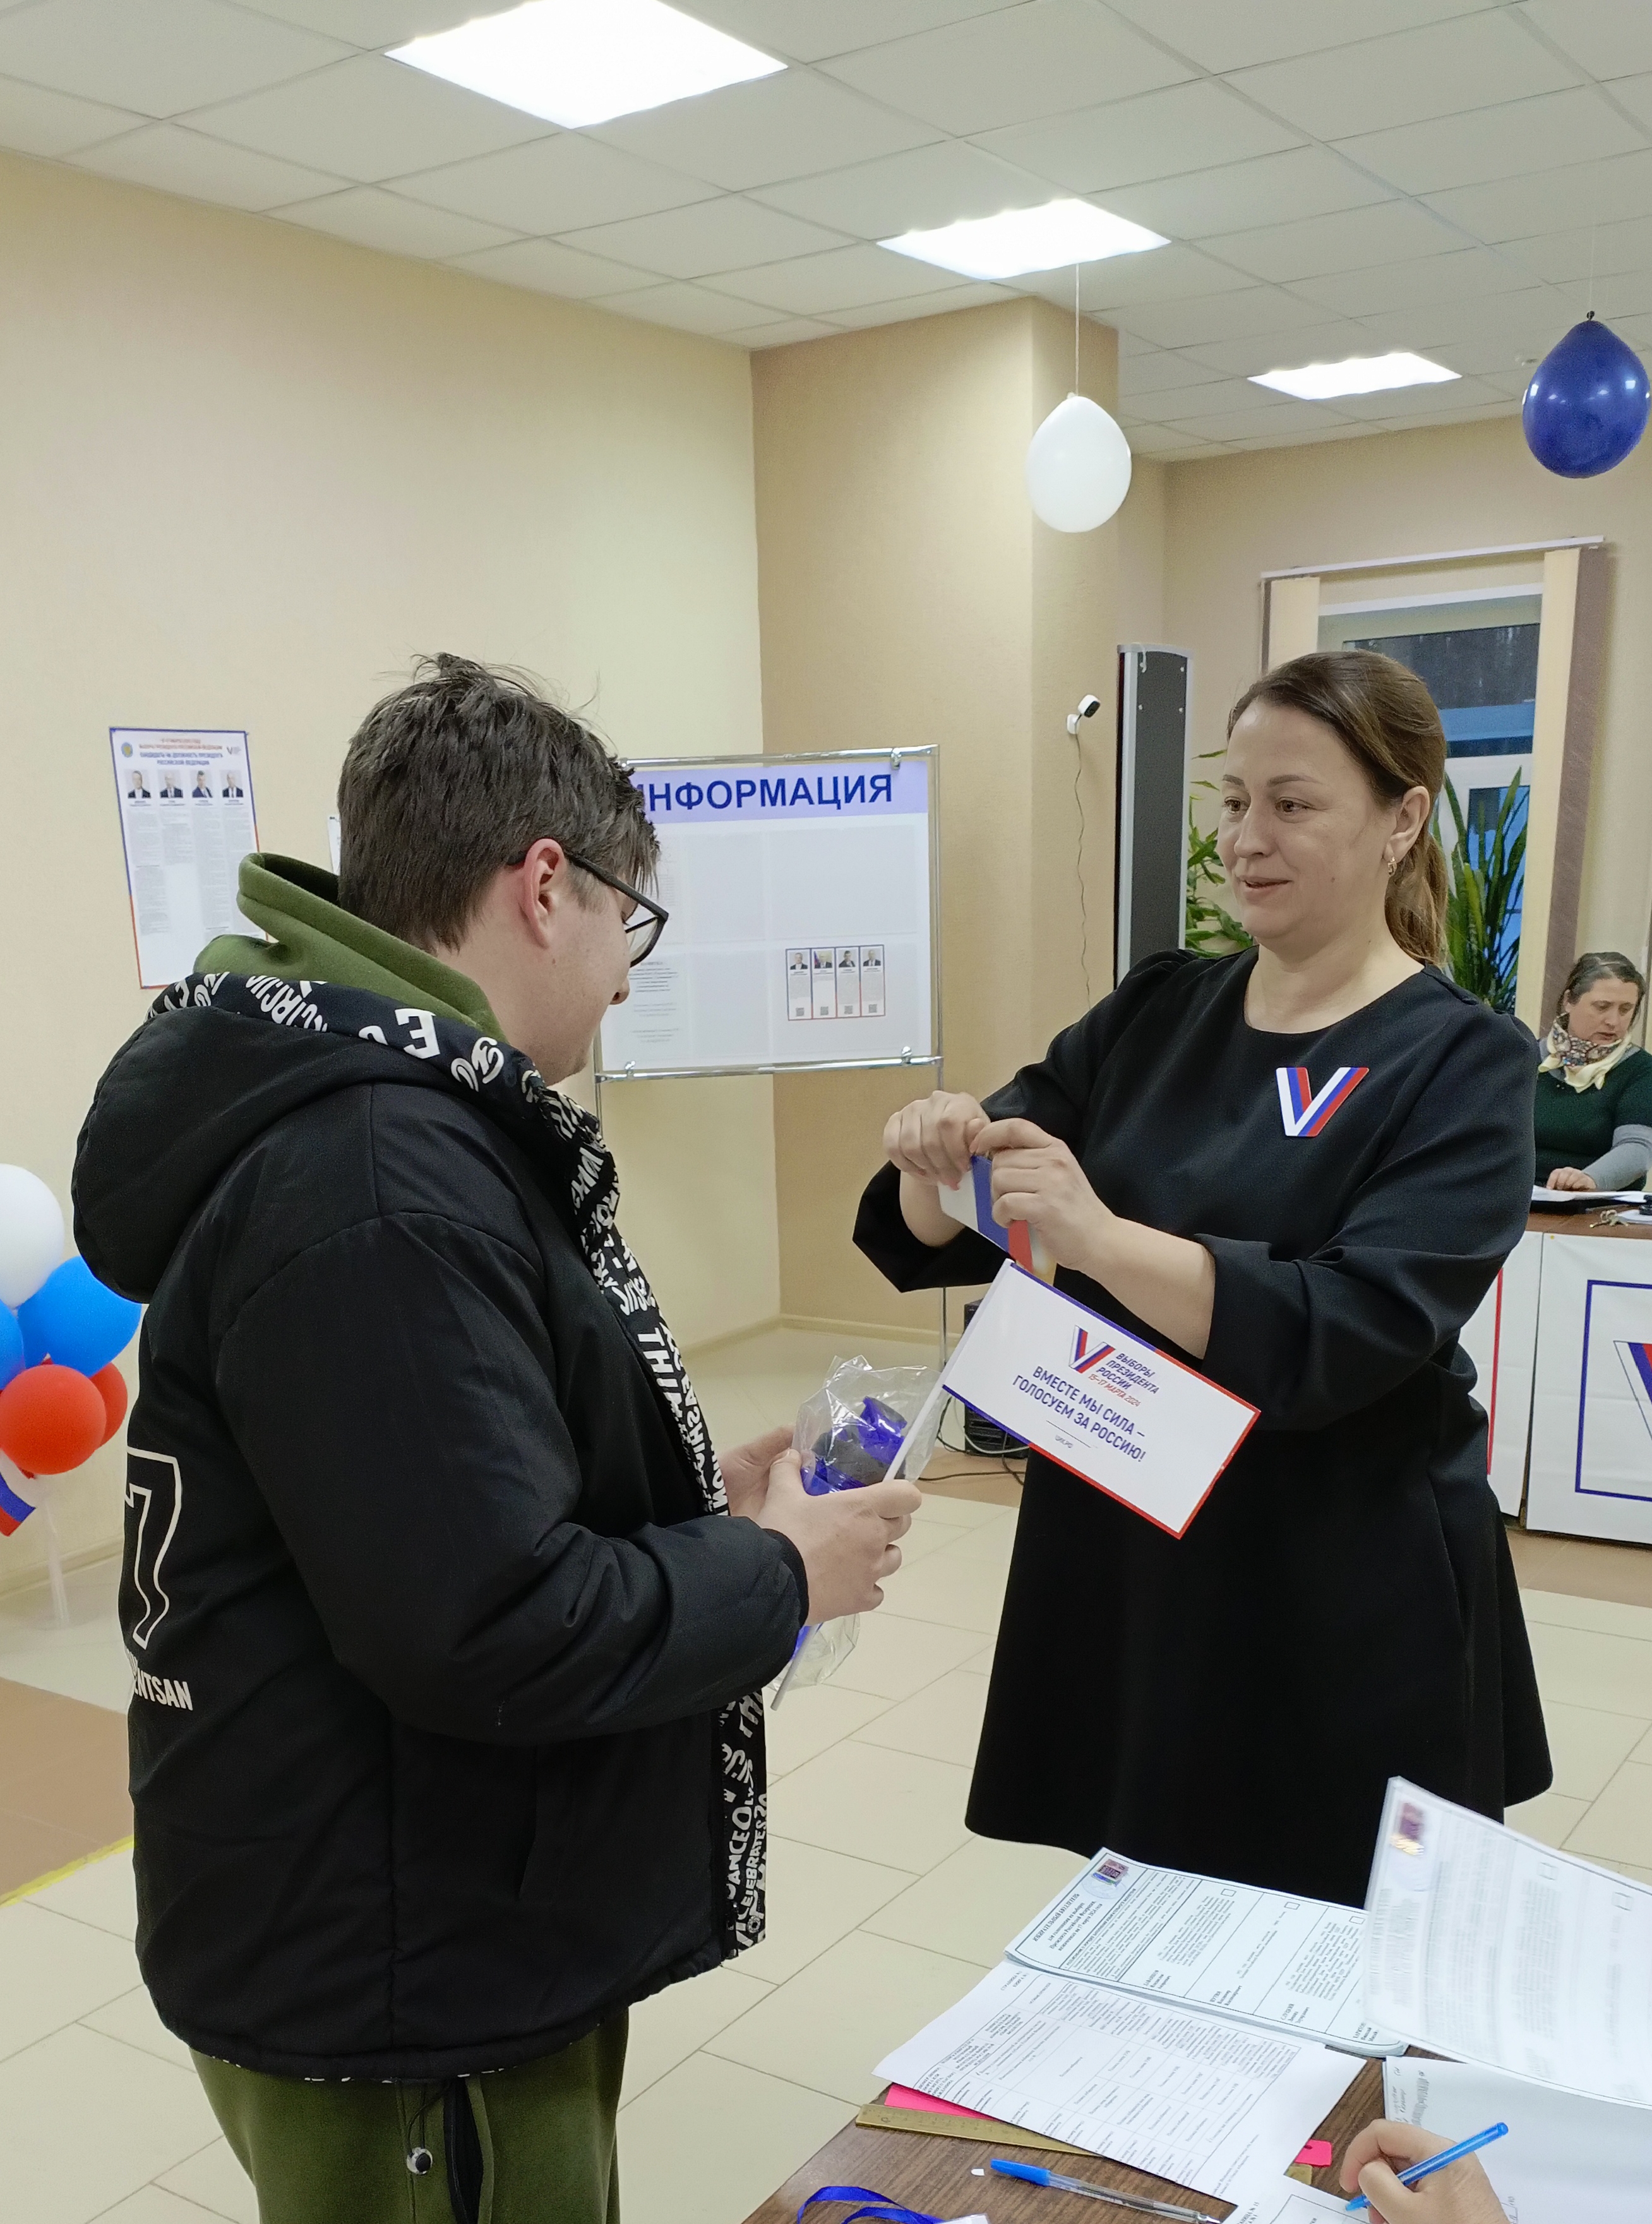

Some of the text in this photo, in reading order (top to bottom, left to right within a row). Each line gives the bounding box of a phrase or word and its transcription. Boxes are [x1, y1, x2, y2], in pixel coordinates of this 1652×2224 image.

[1096, 1367, 1132, 1390] РОССИИ
[1106, 1360, 1160, 1394] ПРЕЗИДЕНТА
[1116, 1353, 1156, 1378] ВЫБОРЫ
[1032, 1366, 1080, 1401] ВМЕСТЕ
[1079, 1394, 1104, 1414] МЫ
[1103, 1408, 1135, 1435] СИЛА
[1104, 1384, 1125, 1399] МАРТА
[1124, 1395, 1141, 1407] 2024
[1012, 1375, 1146, 1462] ГОЛОСУЕМ ЗА РОССИЮ!
